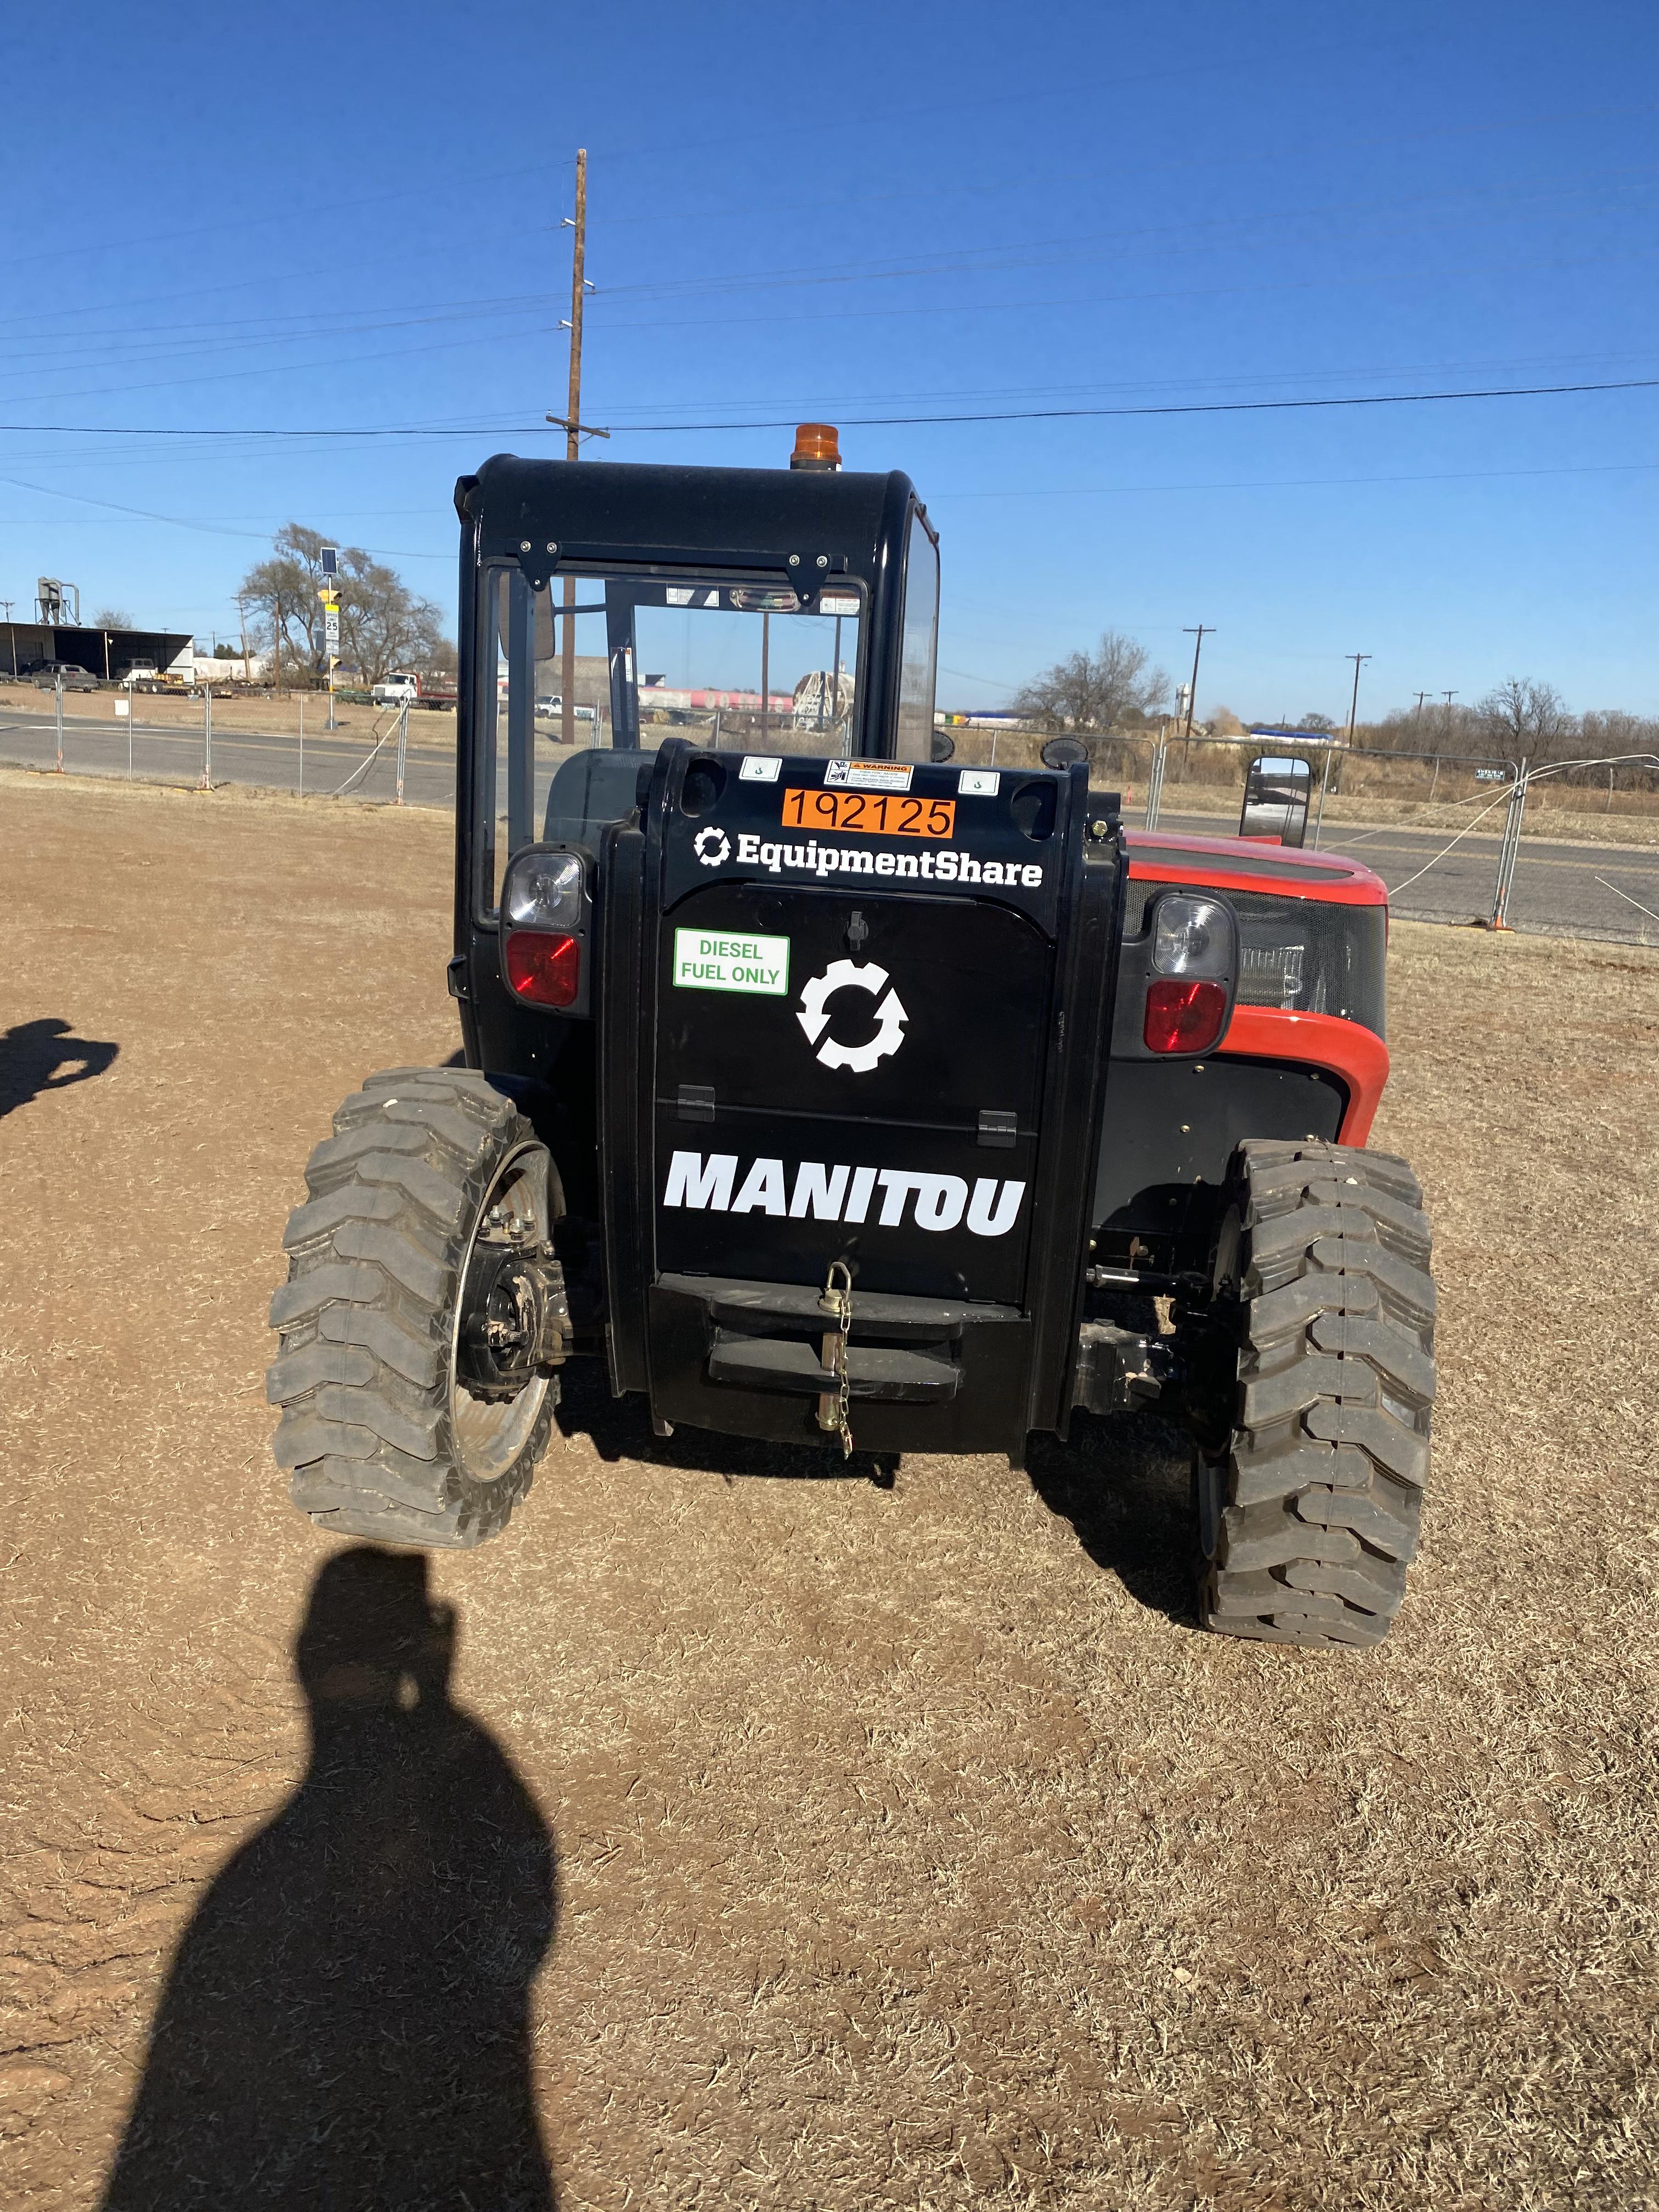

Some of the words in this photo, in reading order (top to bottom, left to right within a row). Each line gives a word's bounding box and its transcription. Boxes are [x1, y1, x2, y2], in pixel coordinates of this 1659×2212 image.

[326, 622, 337, 630] 25
[791, 790, 951, 835] 192125
[736, 833, 1043, 887] EquipmentShare
[699, 939, 763, 961] DIESEL
[681, 962, 727, 981] FUEL
[732, 967, 780, 985] ONLY
[663, 1150, 1026, 1236] MANITOU
